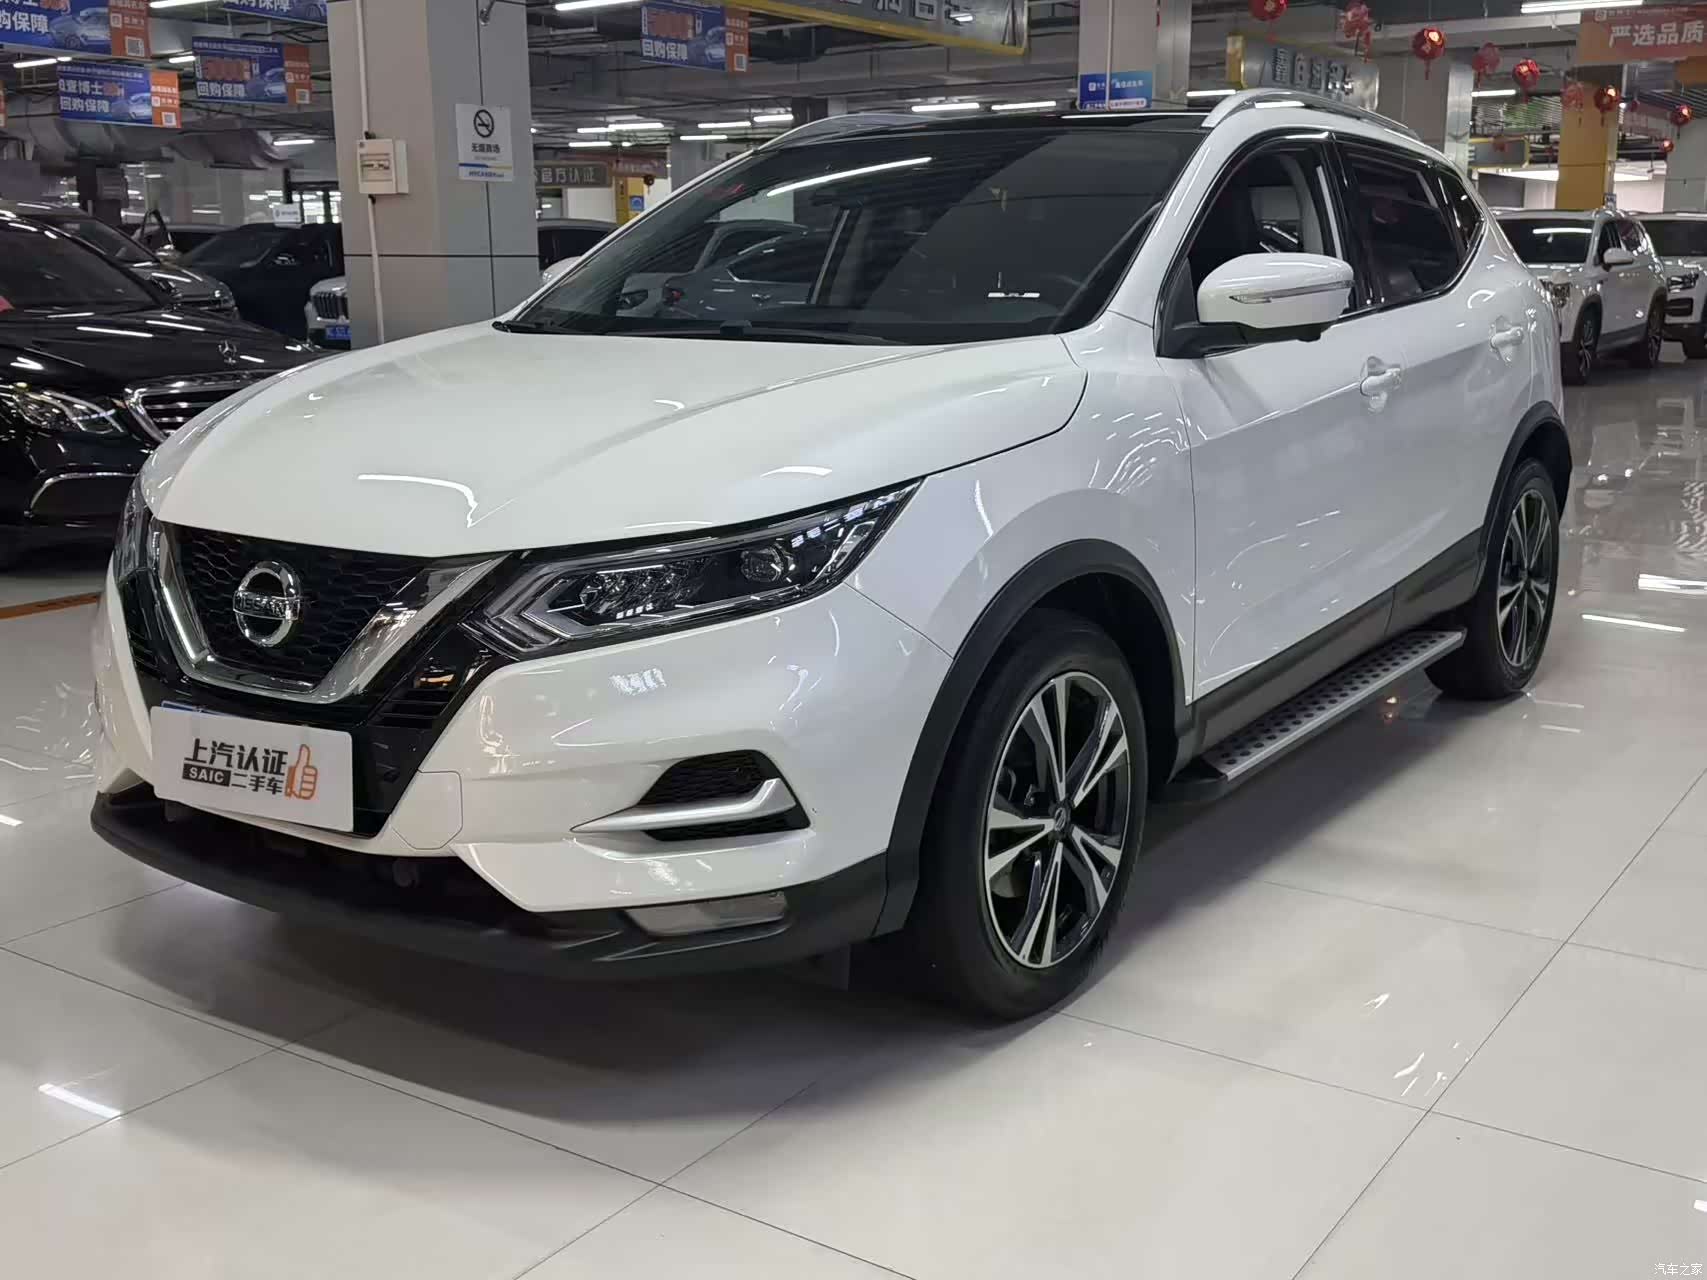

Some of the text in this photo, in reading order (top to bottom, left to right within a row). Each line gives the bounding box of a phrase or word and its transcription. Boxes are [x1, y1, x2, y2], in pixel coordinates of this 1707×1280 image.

[1608, 20, 1704, 48] 严选品质
[196, 81, 246, 97] 回购保障
[60, 96, 110, 113] 回购保障
[534, 167, 597, 184] 官方认证
[184, 738, 288, 776] 上汽认证
[188, 767, 284, 795] SAIC 二手车
